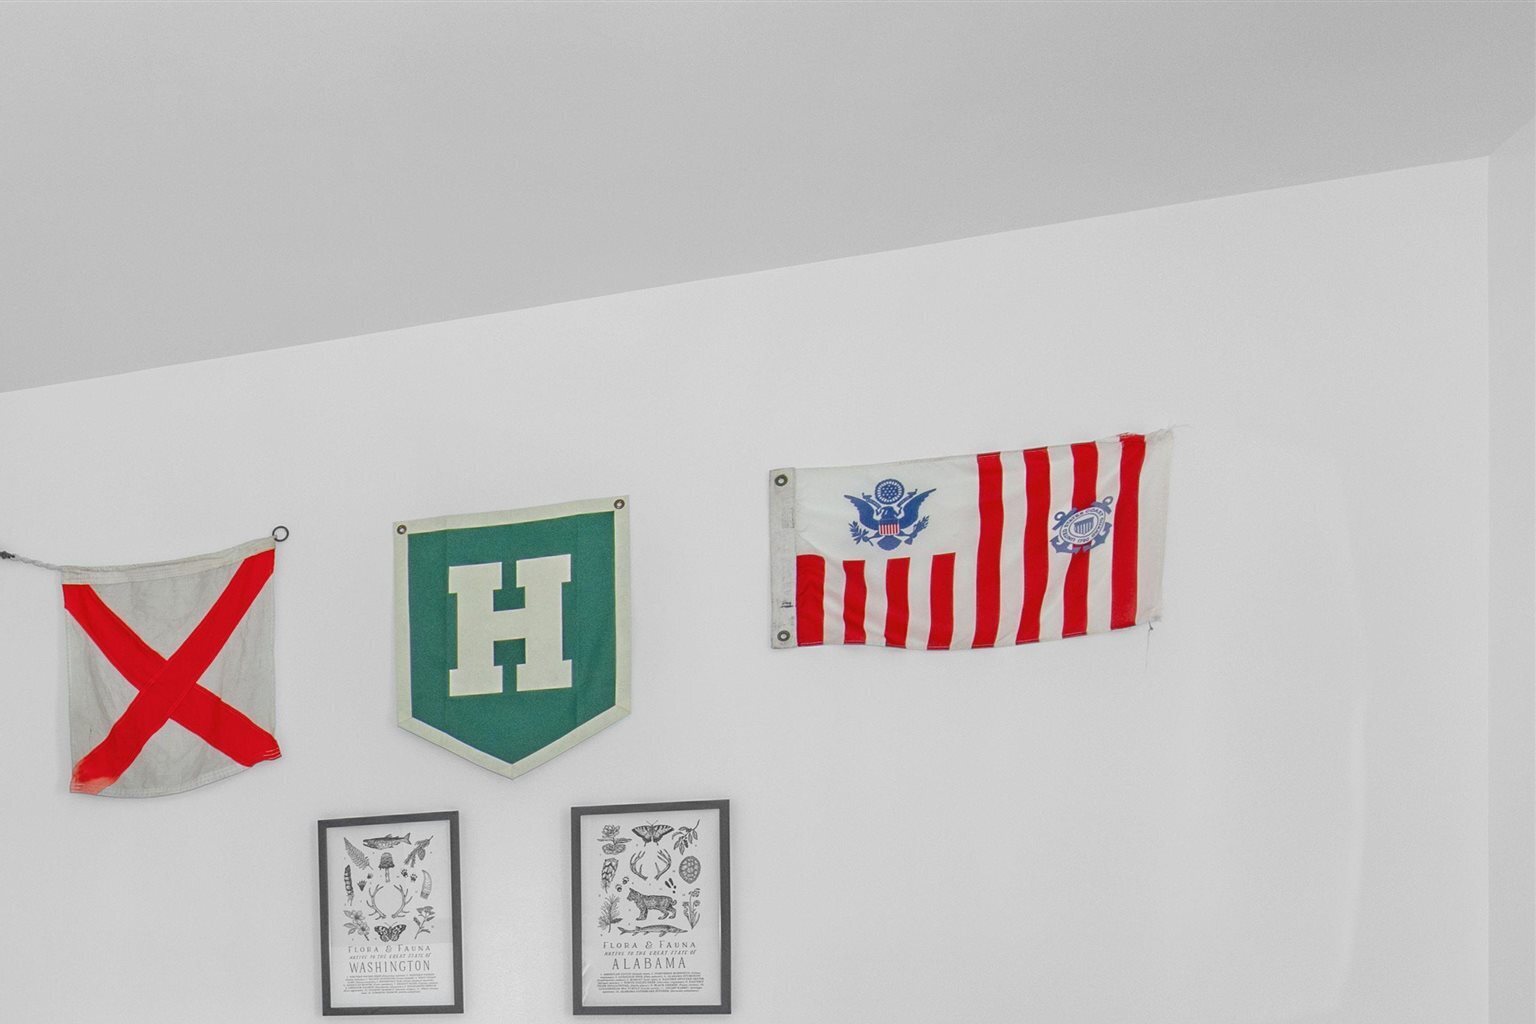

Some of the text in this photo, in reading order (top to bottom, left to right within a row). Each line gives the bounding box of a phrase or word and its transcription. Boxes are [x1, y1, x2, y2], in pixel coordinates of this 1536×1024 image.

[448, 553, 572, 697] H
[385, 945, 393, 953] &
[398, 944, 431, 952] FAUNA
[603, 940, 696, 949] FLORA & FAUNA
[348, 960, 430, 973] WASHINGTON
[612, 957, 686, 970] ALABAMA
